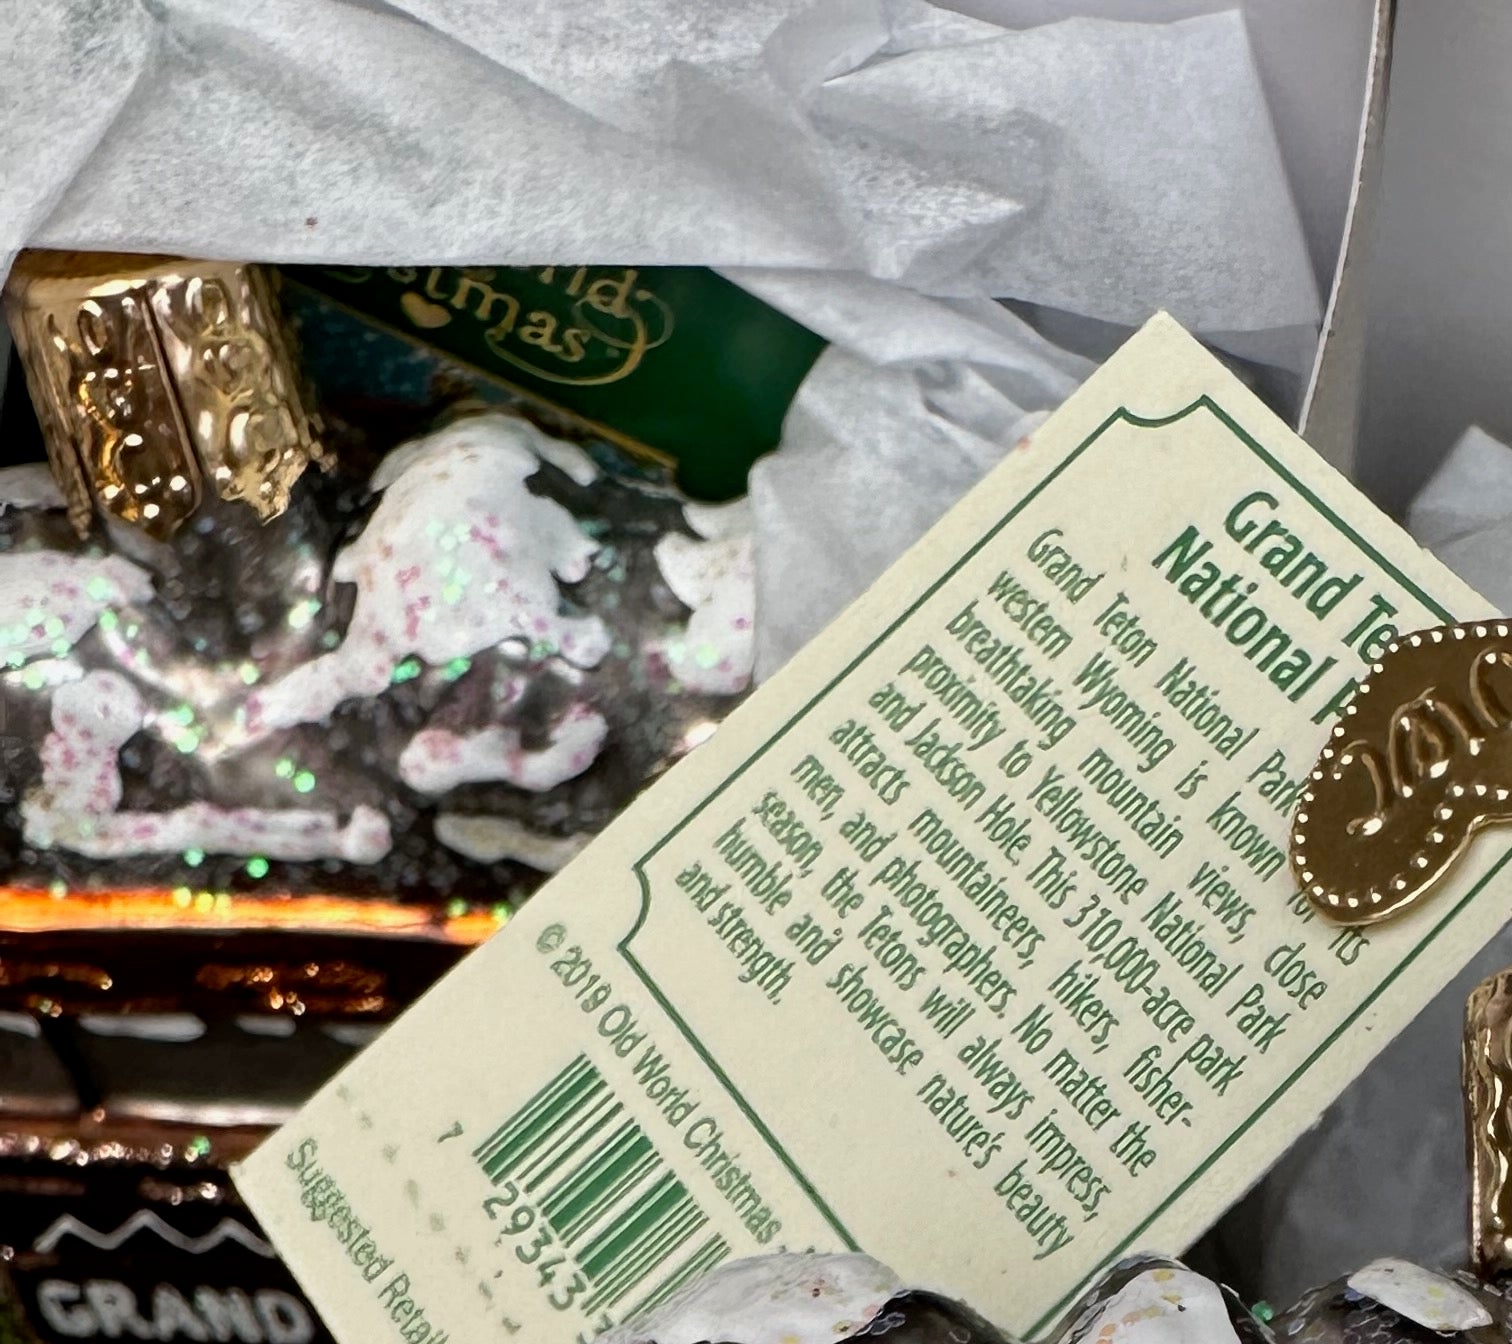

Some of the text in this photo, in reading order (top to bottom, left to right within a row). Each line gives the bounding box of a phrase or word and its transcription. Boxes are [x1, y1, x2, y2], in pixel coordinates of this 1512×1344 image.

[1027, 528, 1106, 605] Grand
[1092, 591, 1159, 669] Teton
[1153, 656, 1261, 761] National
[1151, 524, 1339, 704] National
[1223, 490, 1365, 622] Grand
[897, 644, 1292, 1055] proximity to Yellowstone National Park
[945, 598, 1086, 752] breathtaking
[1077, 747, 1184, 860] mountain
[1187, 861, 1257, 945] views,
[1263, 942, 1328, 1011] close
[987, 570, 1074, 660] western
[1056, 651, 1177, 774] Wyoming
[1173, 759, 1209, 800] is
[1205, 790, 1301, 883] known
[674, 863, 796, 1006] and strength.
[714, 816, 1075, 1261] humble and showcase nature's beauty
[751, 791, 1112, 1223] season, the Tetons will always impress,
[790, 754, 1157, 1178] men, and photographers. No matter the
[828, 719, 1194, 1128] attracts mountaineers, hikers, fisher-
[868, 682, 1248, 1097] and Jackson Hole. This 310,000-acre park
[287, 1138, 395, 1284] Suggested
[482, 1181, 587, 1311] 29343
[549, 946, 612, 1013] 2019
[598, 1004, 648, 1058] Old
[632, 1045, 700, 1128] World
[683, 1117, 782, 1244] Christmas
